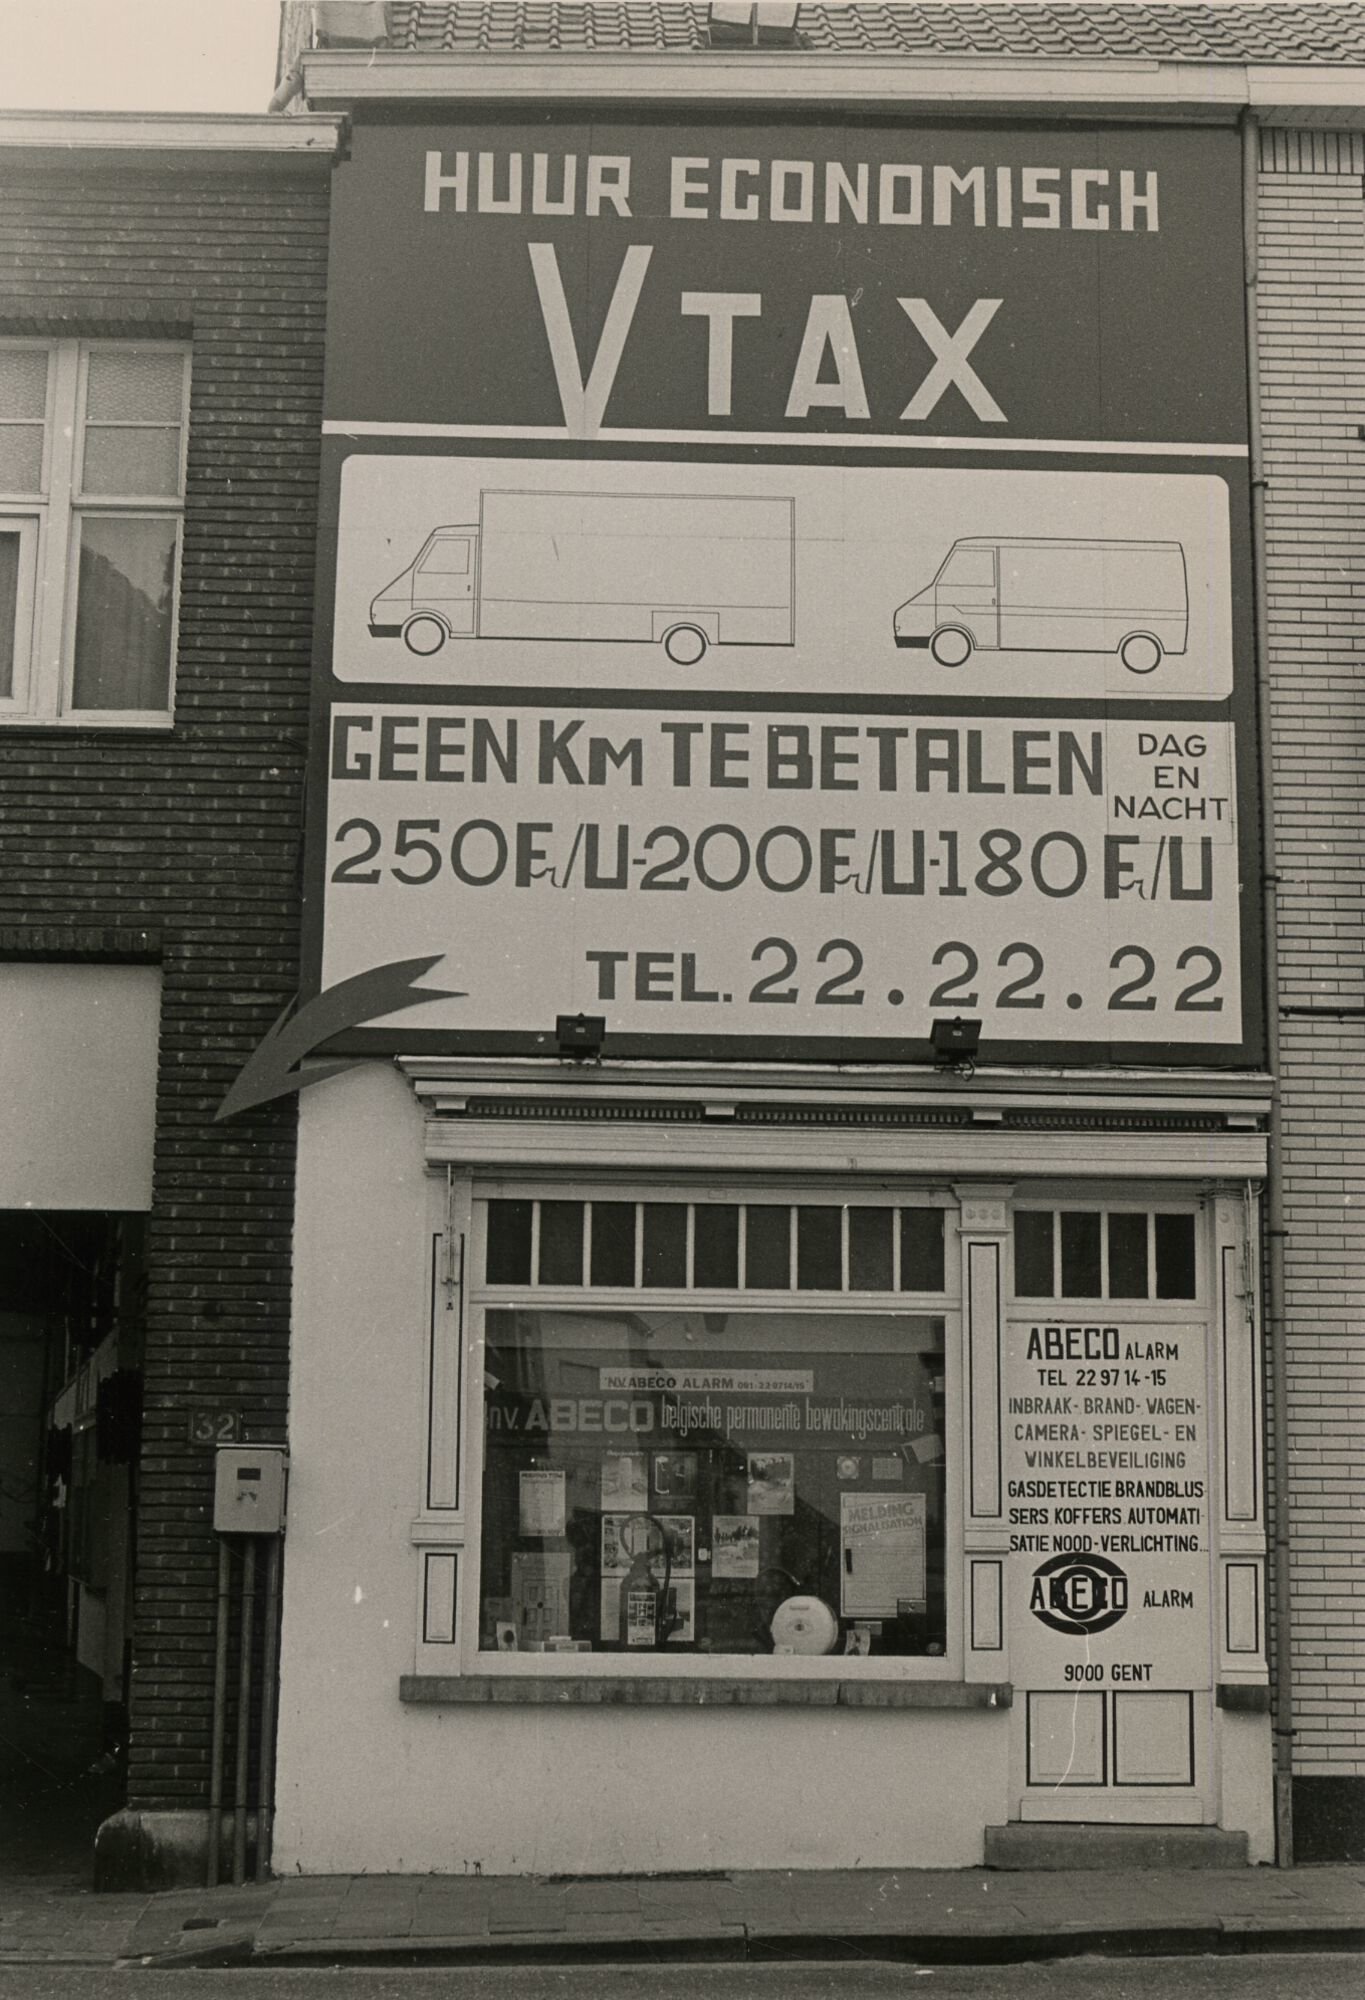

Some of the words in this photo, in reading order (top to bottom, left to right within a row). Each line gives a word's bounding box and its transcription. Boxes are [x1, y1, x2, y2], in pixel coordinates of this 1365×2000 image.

[424, 151, 632, 217] HUUR
[669, 156, 1159, 232] ECONOMISCH
[331, 715, 518, 784] GEEN
[660, 722, 750, 789] TE
[766, 724, 1103, 796] BETALEN
[1138, 733, 1207, 758] DAG
[1154, 765, 1199, 789] EN
[1114, 795, 1229, 821] NACHT
[585, 950, 733, 1003] TEL.
[1026, 1327, 1120, 1360] ABECO
[1125, 1341, 1179, 1361] ALARM
[628, 1376, 677, 1389] ABECO
[682, 1377, 734, 1390] ALARM
[1037, 1368, 1068, 1387] TEL
[1008, 1396, 1079, 1415] INBRAAK-
[1083, 1396, 1141, 1416] BRAND-
[1145, 1397, 1201, 1416] WAGEN-
[195, 1412, 234, 1440] 32
[524, 1400, 655, 1433] ABECO
[660, 1395, 721, 1438] belgische
[726, 1401, 801, 1441] permanente
[1014, 1423, 1086, 1442] CAMERA-
[1092, 1423, 1169, 1442] SPIEGEL-
[1175, 1424, 1197, 1442] EN
[1024, 1450, 1186, 1469] WINKELBEVEILIGING
[1007, 1480, 1112, 1499] GASDETECTIE
[1009, 1534, 1050, 1552] SATIE
[1143, 1589, 1194, 1609] ALARM
[1064, 1663, 1104, 1682] 9000
[1111, 1663, 1153, 1682] GENT
